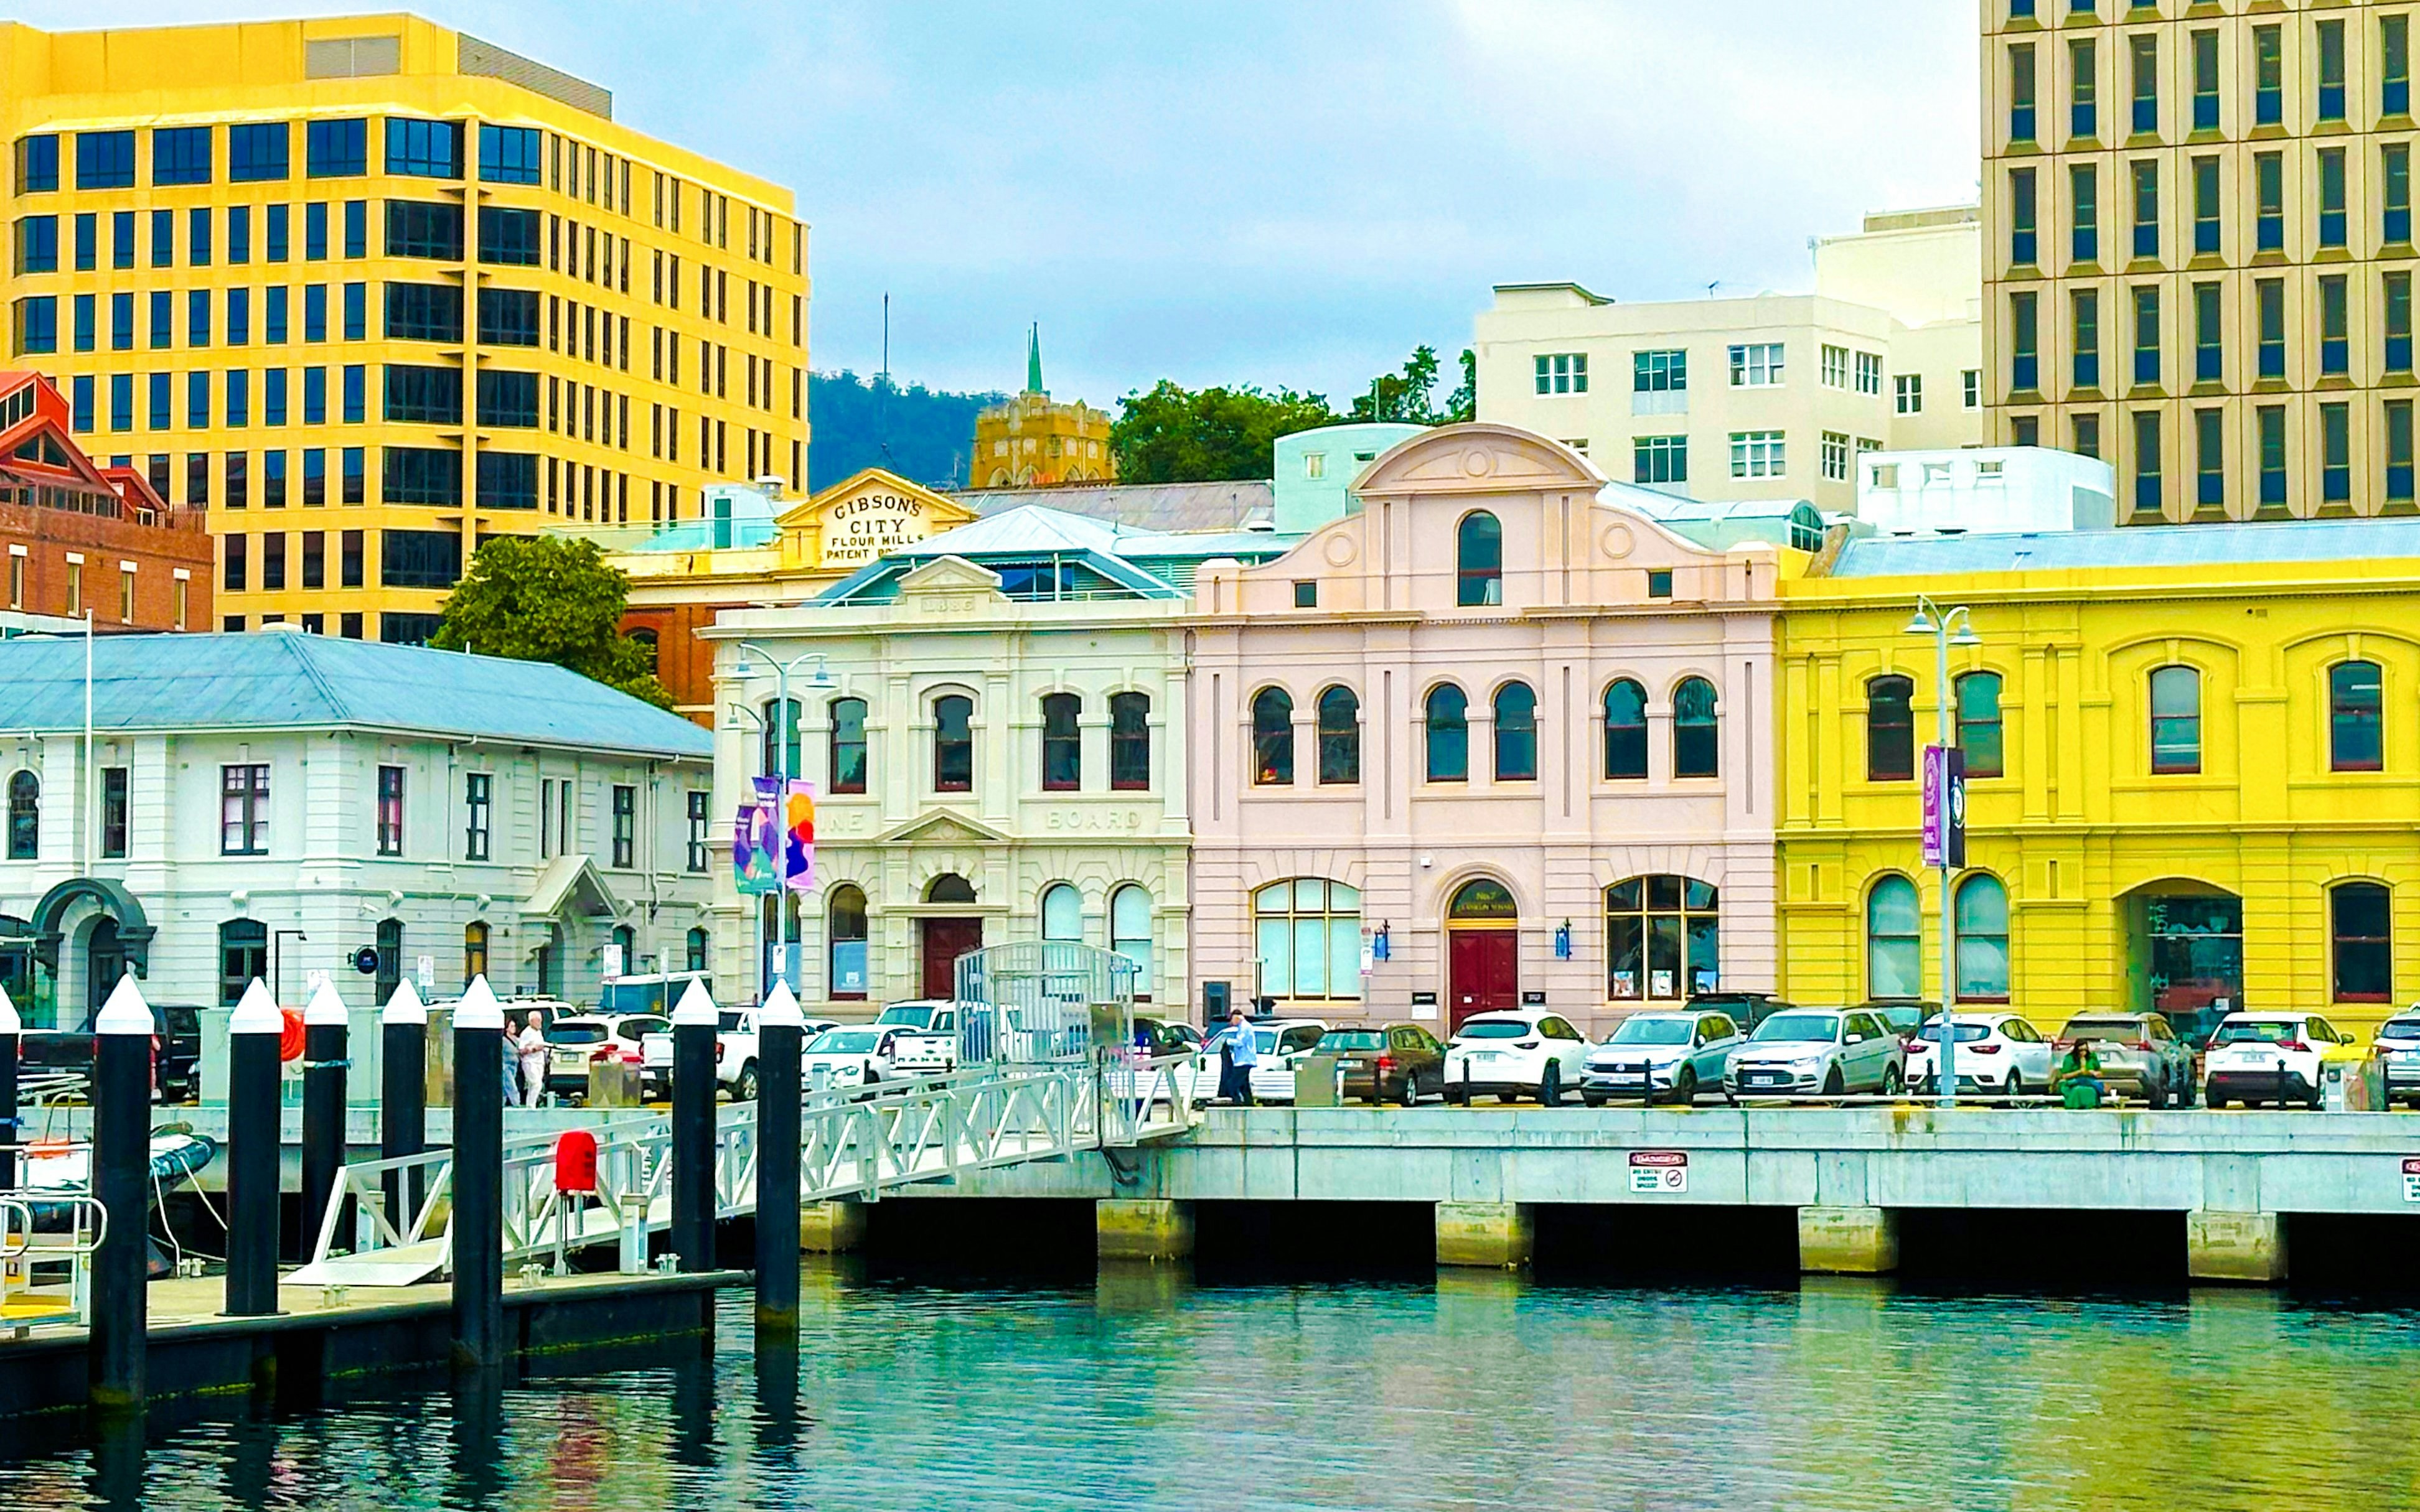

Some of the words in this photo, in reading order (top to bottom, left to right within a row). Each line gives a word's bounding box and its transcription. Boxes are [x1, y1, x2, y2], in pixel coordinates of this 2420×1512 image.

[835, 495, 922, 520] GIBSON'S
[850, 518, 905, 534] CITY
[832, 537, 875, 547] FLOUR
[882, 534, 924, 545] MILLS
[827, 549, 869, 559] PATENT
[1047, 811, 1142, 829] BOARD
